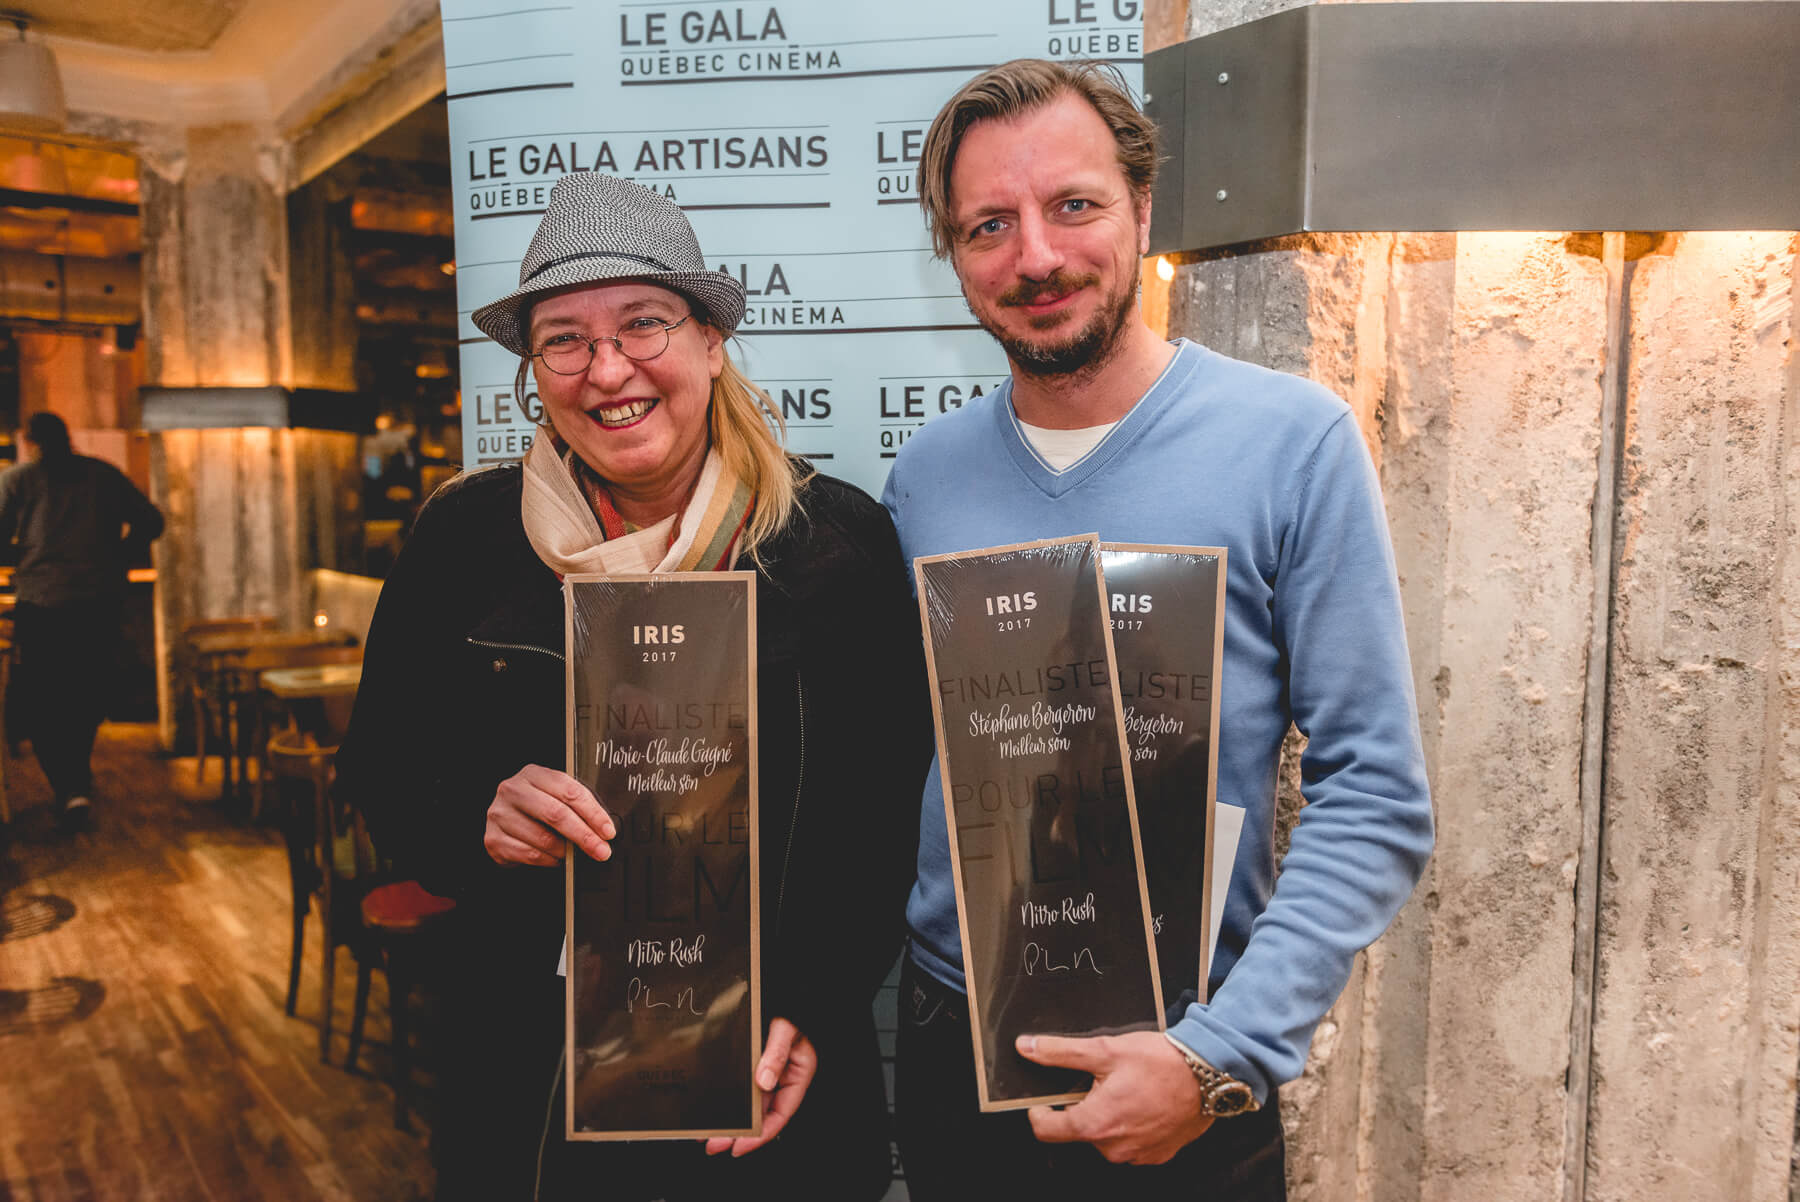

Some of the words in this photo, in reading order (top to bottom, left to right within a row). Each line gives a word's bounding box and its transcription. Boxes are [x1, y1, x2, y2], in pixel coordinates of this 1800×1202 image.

[620, 12, 668, 47] LE
[680, 7, 787, 43] GALA
[1049, 0, 1097, 25] LE
[468, 147, 507, 182] LE
[519, 141, 619, 175] GALA
[634, 135, 829, 172] ARTISANS
[877, 129, 923, 164] LE
[718, 263, 791, 296] LA
[476, 393, 513, 425] LE
[880, 386, 925, 418] LE
[985, 591, 1038, 616] IRIS
[1111, 593, 1153, 613] RIS
[633, 624, 686, 645] IRIS
[998, 618, 1032, 632] 2017
[1109, 619, 1143, 631] 2017
[642, 651, 677, 663] 2017
[938, 658, 1107, 703] FINALISTE
[1119, 671, 1209, 702] LISTE
[576, 703, 745, 731] FINALISTE
[969, 703, 1031, 741] Stéphane
[1031, 701, 1096, 735] Bergeron
[595, 737, 690, 769] Marie-Claude
[690, 737, 733, 777] Gagné
[1000, 733, 1046, 759] Meilleur
[1047, 737, 1071, 754] son
[1134, 746, 1158, 762] son
[628, 768, 677, 795] Meilleur
[678, 774, 699, 795] son
[951, 774, 1062, 815] POUR
[1021, 899, 1059, 929] Nitro
[1062, 892, 1096, 926] Rush
[627, 938, 667, 969] Nitro
[669, 934, 706, 969] Rush
